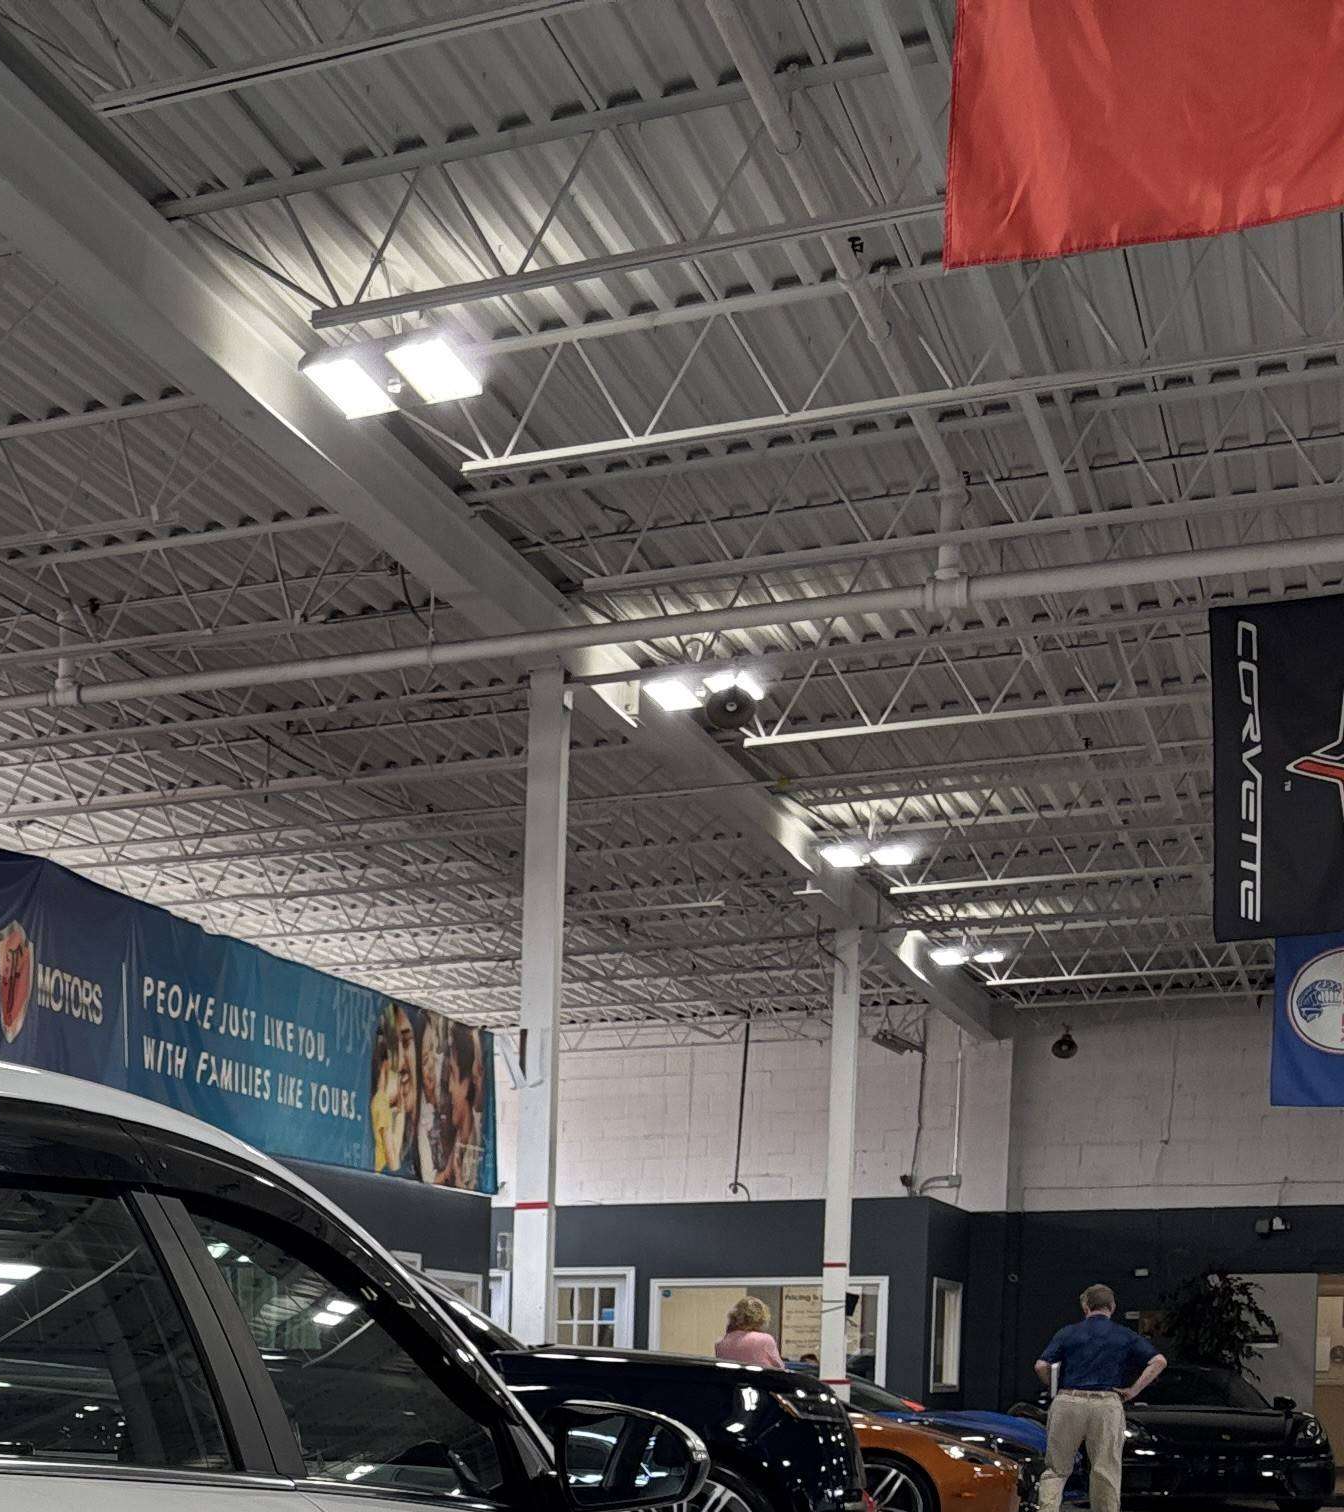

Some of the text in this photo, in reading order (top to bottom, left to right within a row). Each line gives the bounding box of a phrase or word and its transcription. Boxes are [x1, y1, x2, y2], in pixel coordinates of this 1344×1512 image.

[1237, 620, 1262, 923] CORVETTE
[37, 963, 104, 1026] MOTORS
[219, 1002, 257, 1042] JUST
[264, 1014, 294, 1053] LIKE
[298, 1026, 330, 1068] YOU,
[142, 1035, 362, 1121] WITH FAMILIES LIKE YOURS.
